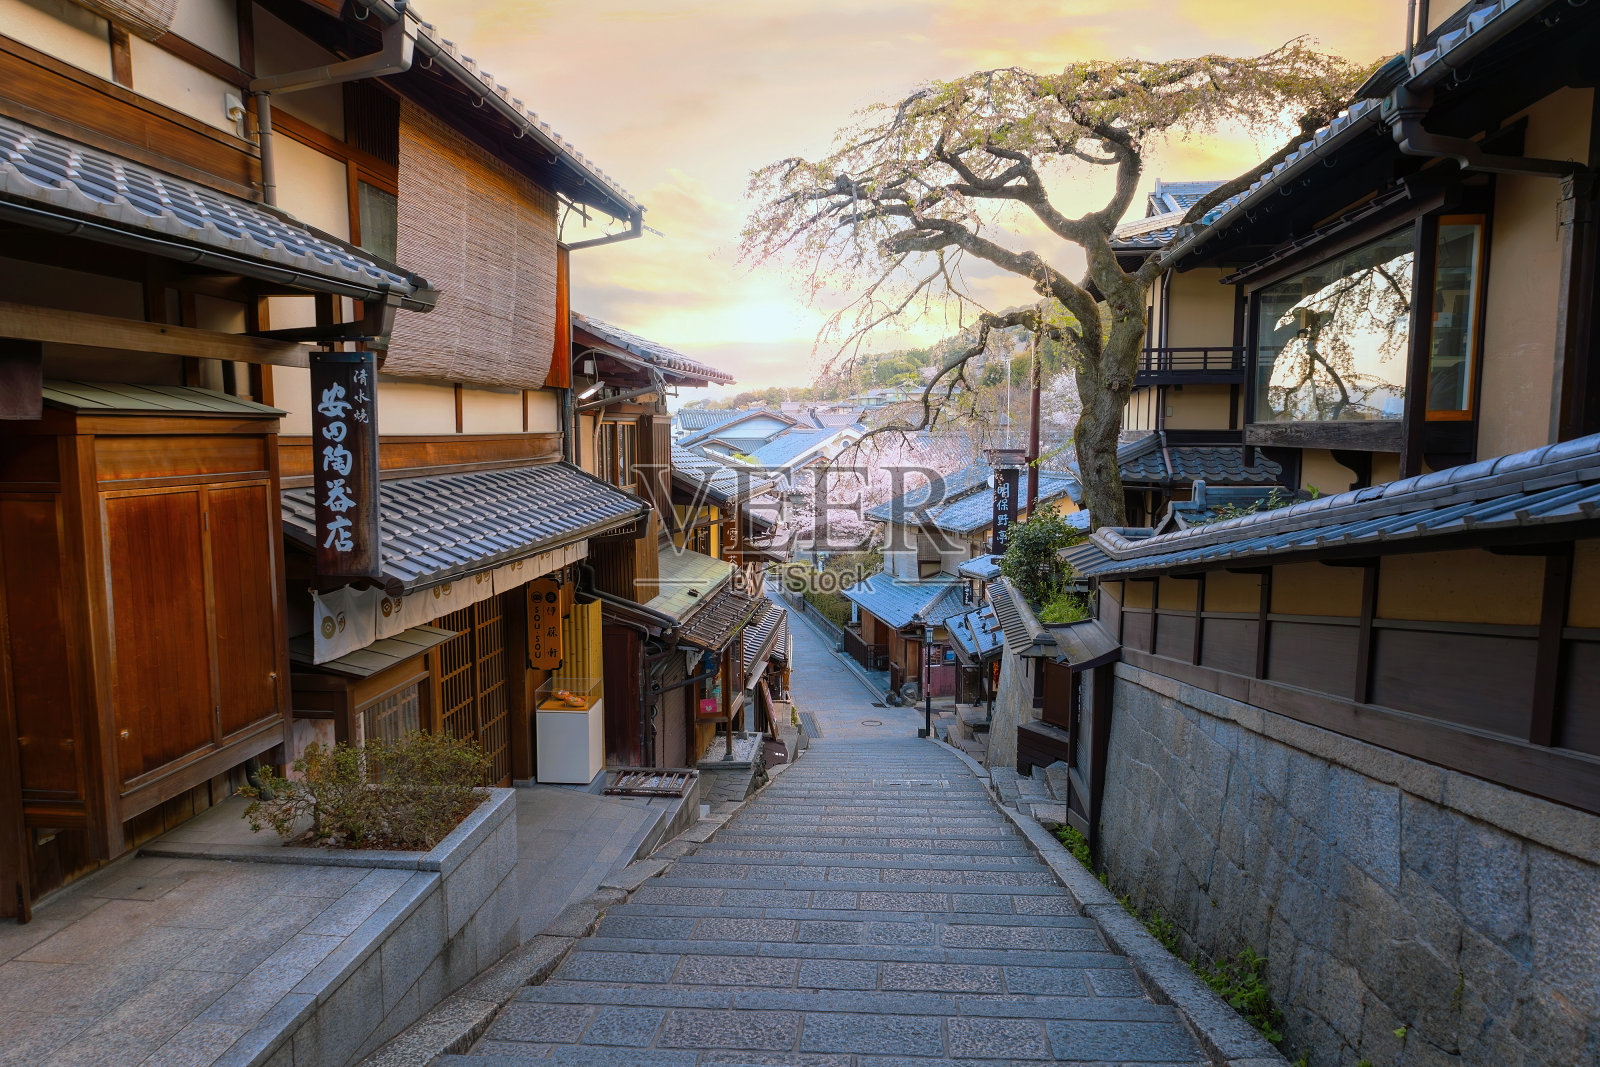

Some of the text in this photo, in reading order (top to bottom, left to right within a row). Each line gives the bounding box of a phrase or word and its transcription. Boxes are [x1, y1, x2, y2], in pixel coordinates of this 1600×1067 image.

[318, 382, 357, 553] 安田陶器店
